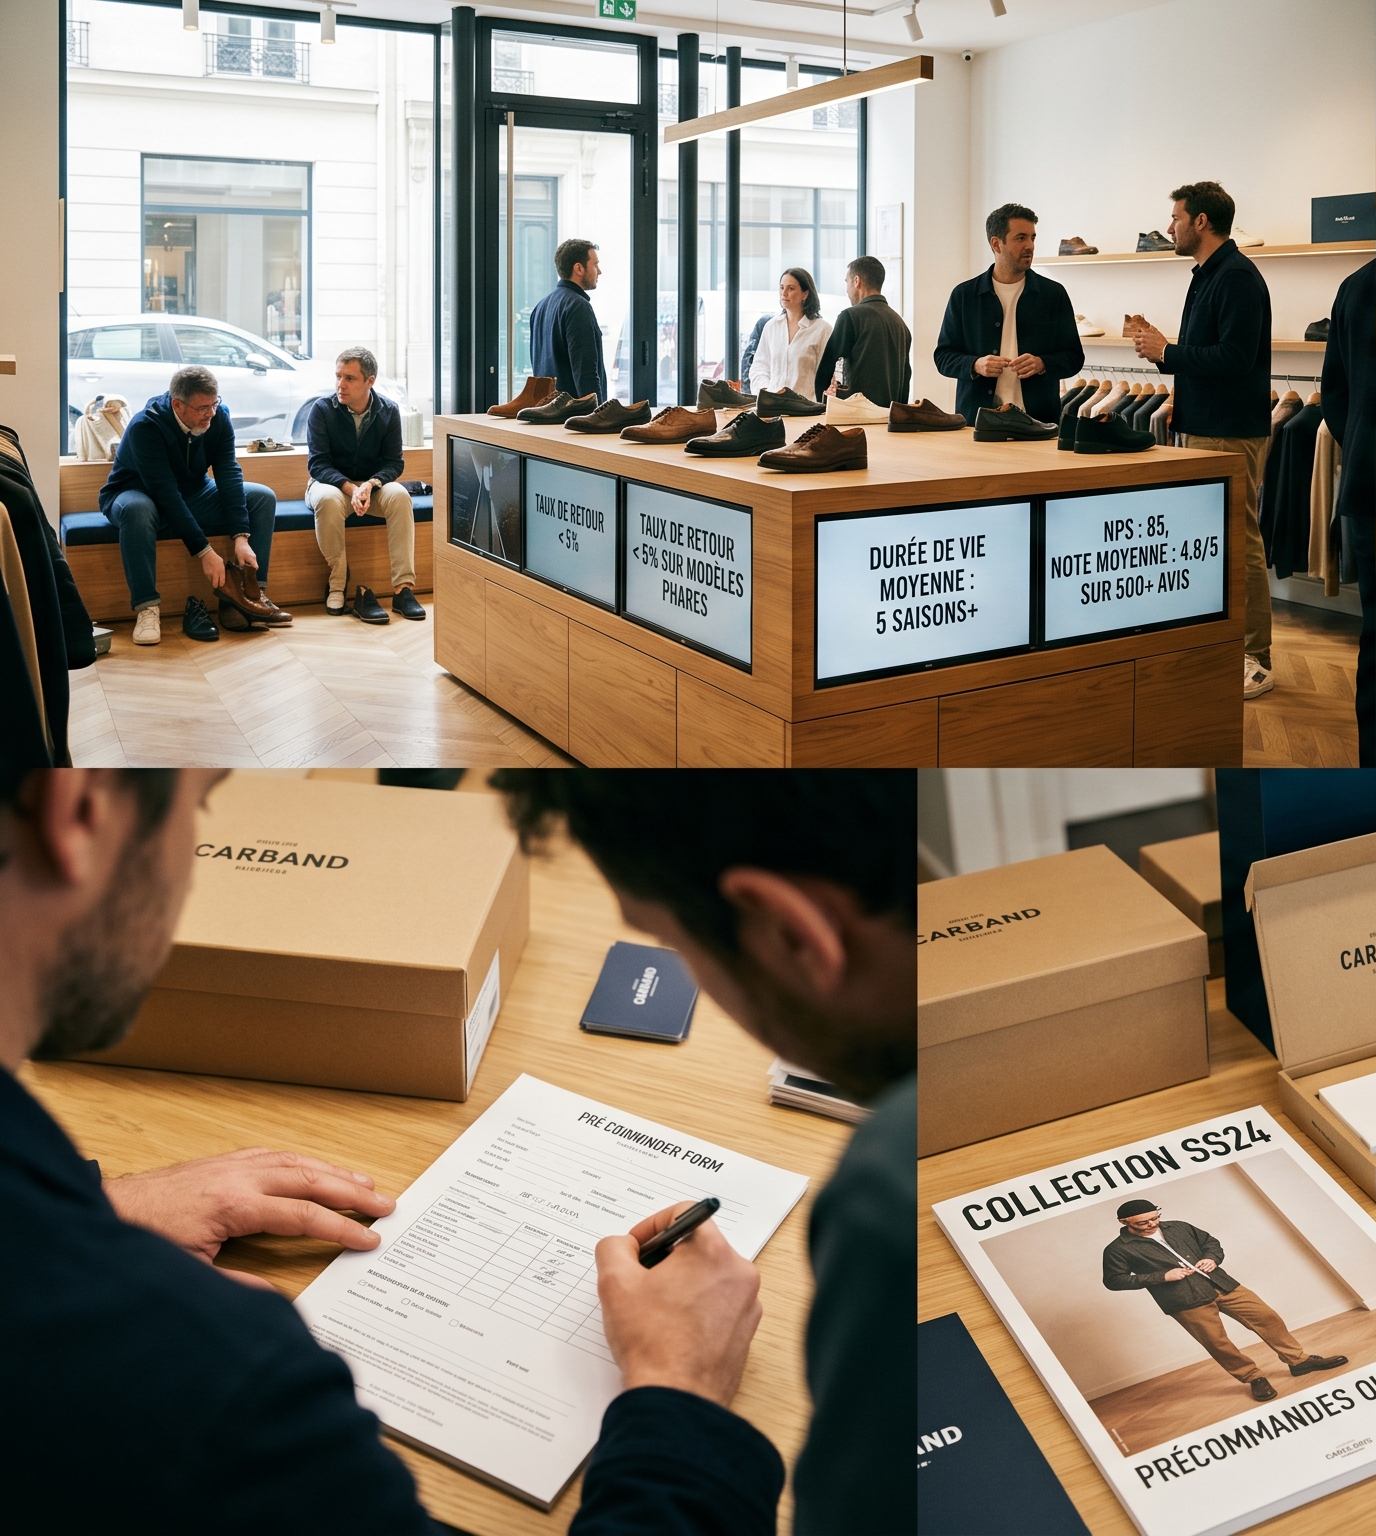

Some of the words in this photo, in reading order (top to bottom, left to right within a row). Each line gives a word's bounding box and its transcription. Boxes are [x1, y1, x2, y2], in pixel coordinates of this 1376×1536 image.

[535, 493, 556, 518] TAUX
[558, 500, 569, 522] DE
[570, 504, 605, 533] RETOUR
[1104, 518, 1135, 543] NPS
[1146, 514, 1169, 539] 85,
[640, 512, 667, 541] TAUX
[670, 520, 684, 546] DE
[687, 524, 735, 562] RETOUR
[869, 536, 928, 571] DURÉE
[933, 538, 955, 563] DE
[959, 534, 986, 559] VIE
[633, 547, 639, 560] <
[642, 543, 659, 569] 5%
[661, 549, 683, 577] SUR
[686, 555, 744, 598] MODÈLES
[1051, 553, 1092, 580] NOTE
[1096, 543, 1168, 573] MOYENNE
[1180, 536, 1219, 562] 4.8/5
[662, 579, 708, 617] PHARES
[880, 569, 965, 602] MOYENNE
[1080, 580, 1112, 605] SUR
[1115, 574, 1154, 601] 500+
[1158, 569, 1190, 594] AVIS
[876, 611, 886, 635] 5
[892, 600, 979, 633] SAISONS+
[194, 843, 350, 870] CARBAND
[681, 1150, 725, 1173] FORM
[962, 1145, 1181, 1232] COLLECTION
[1181, 1119, 1272, 1164] SS24
[1135, 1387, 1356, 1490] PRÉCOMMANDES
